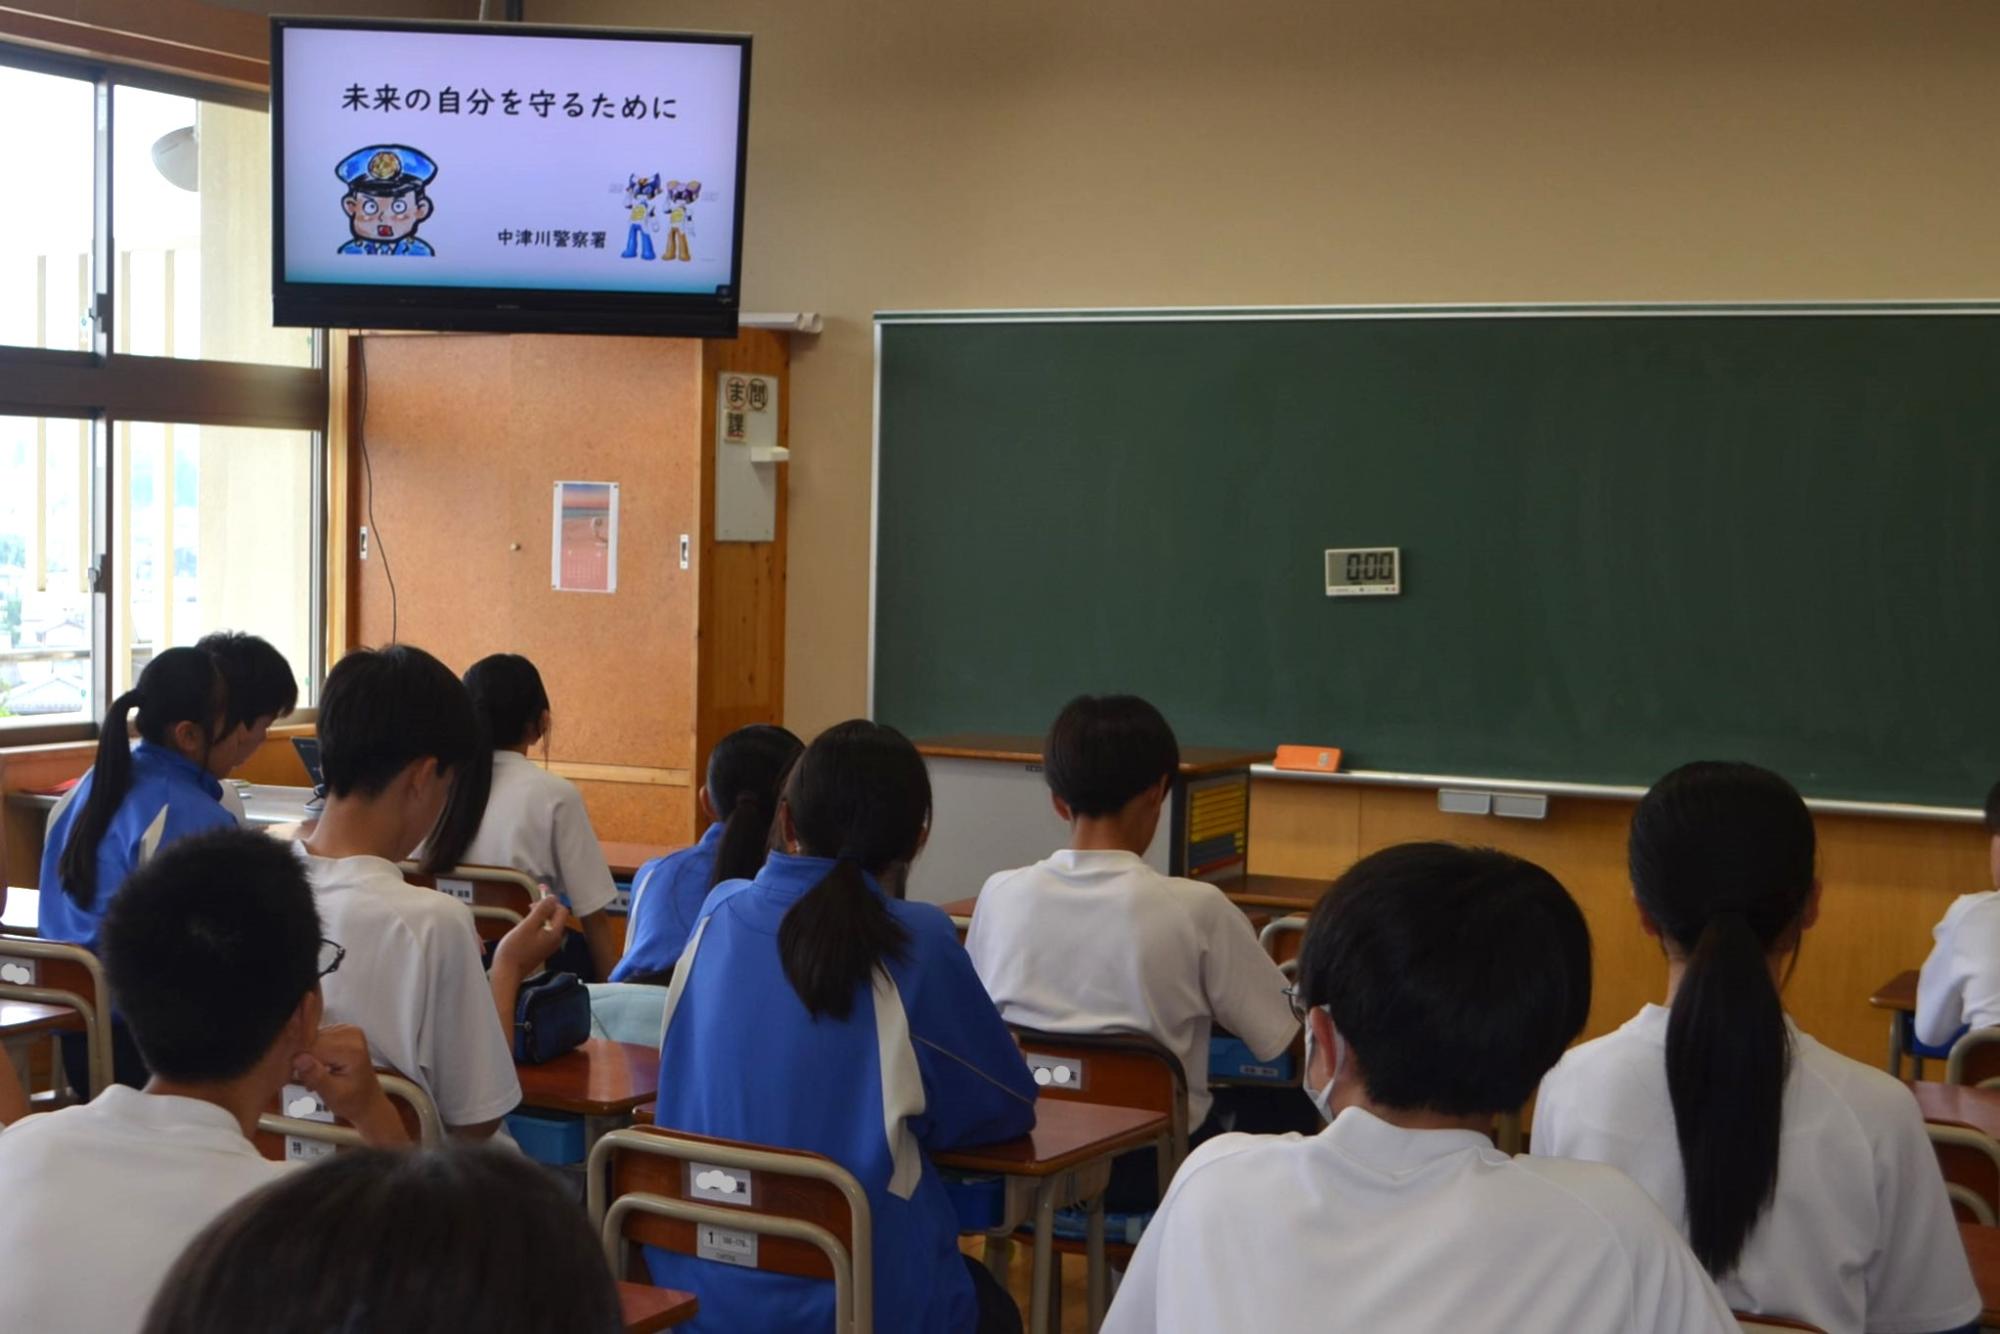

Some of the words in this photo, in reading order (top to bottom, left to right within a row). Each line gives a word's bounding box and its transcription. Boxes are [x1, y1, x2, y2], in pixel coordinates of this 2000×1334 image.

[341, 82, 677, 119] 未来の自分を守るために
[497, 228, 606, 248] 中津川警察署
